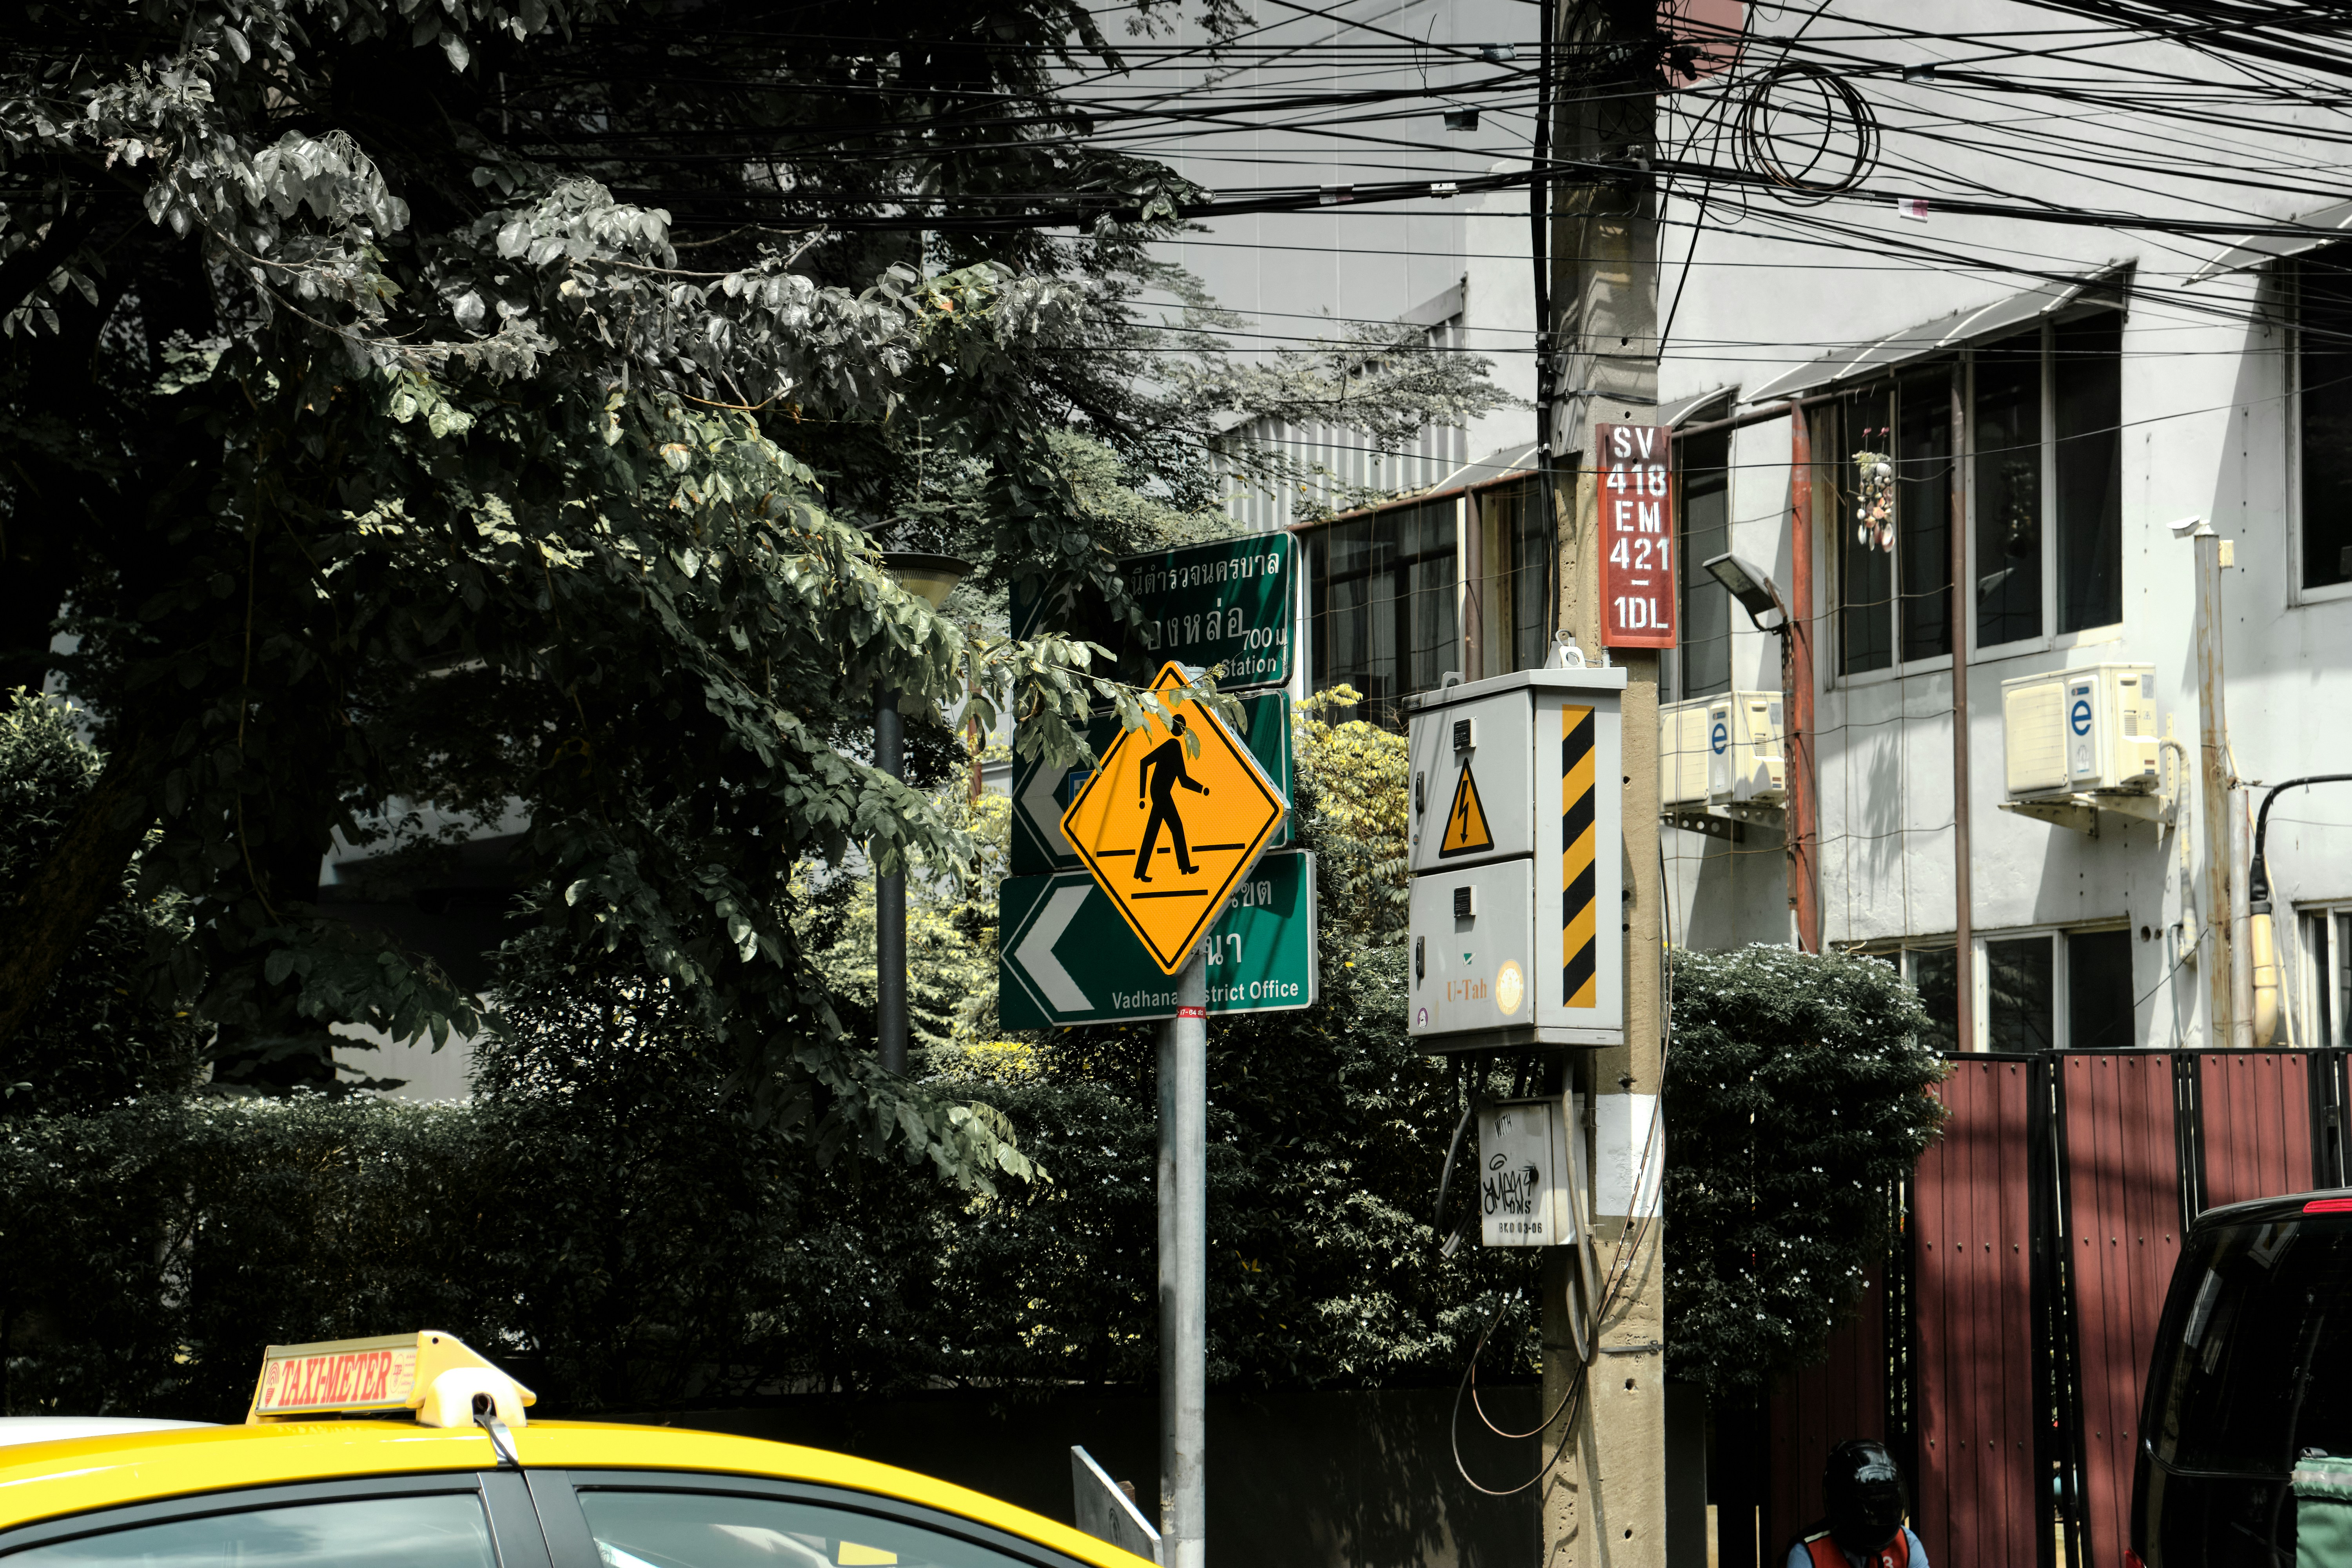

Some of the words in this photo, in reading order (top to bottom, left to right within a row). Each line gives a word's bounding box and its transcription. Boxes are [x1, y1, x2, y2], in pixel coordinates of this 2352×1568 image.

[1613, 427, 1655, 459] SV
[1607, 463, 1667, 496] 418
[1615, 501, 1661, 533] EM
[1610, 537, 1669, 571] 421
[1131, 553, 1279, 596] นีตำรวจนครบาล
[1148, 598, 1243, 650] องหล่อ
[1614, 596, 1669, 629] 1DL
[1242, 627, 1272, 651] 700
[1221, 655, 1276, 678] Station
[1112, 989, 1177, 1009] Vadhana
[1205, 983, 1245, 1003] strict
[1250, 980, 1299, 1000] Office
[1447, 978, 1487, 1002] U-Tah
[278, 1351, 392, 1406] TAXI-METER
